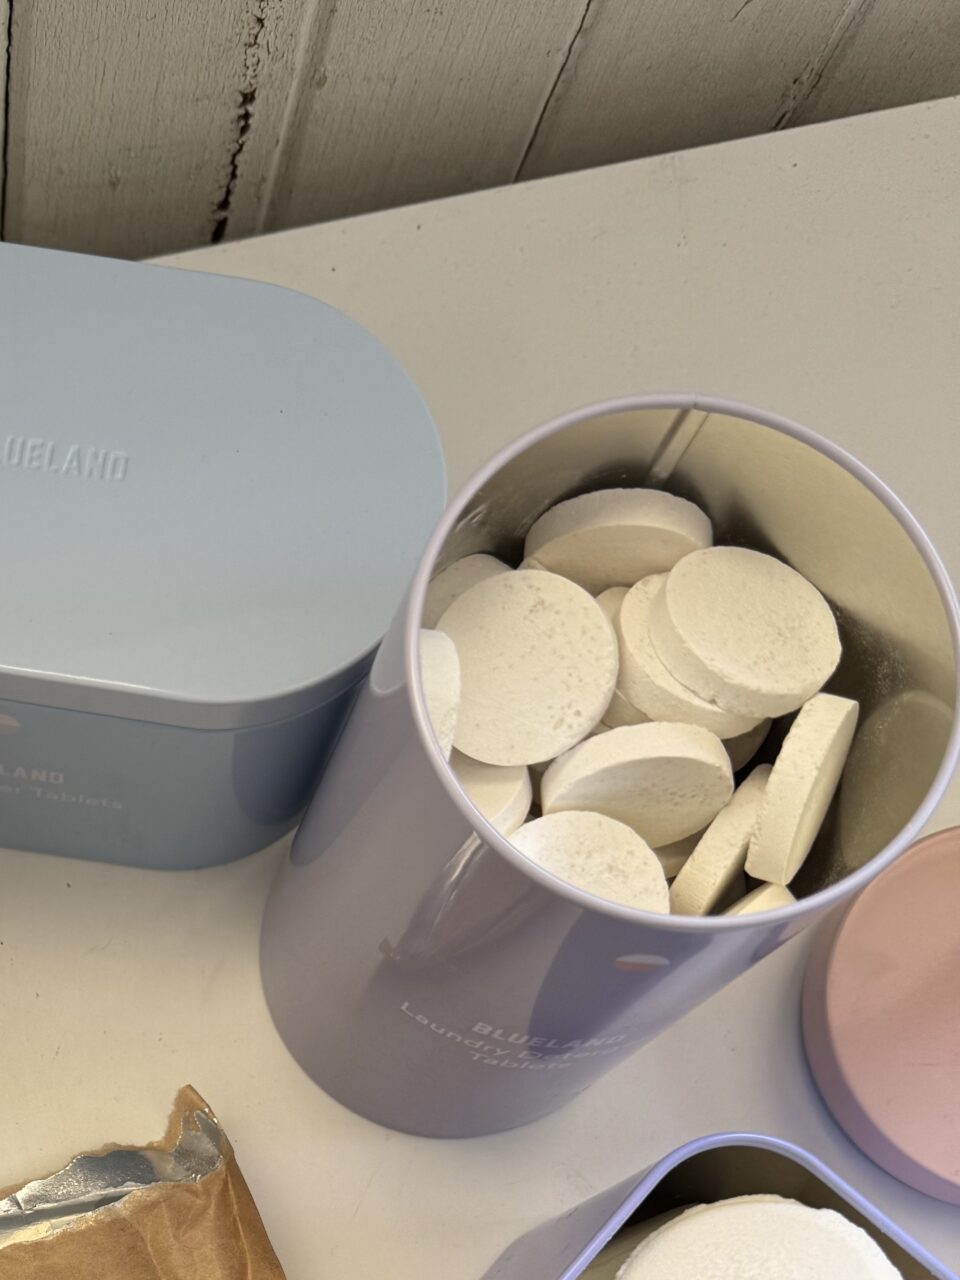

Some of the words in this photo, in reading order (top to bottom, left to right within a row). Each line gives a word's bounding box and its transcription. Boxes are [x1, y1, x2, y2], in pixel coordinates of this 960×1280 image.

[30, 786, 123, 809] Tablets
[400, 1001, 511, 1056] Laundry
[471, 1022, 628, 1048] BLUELAND
